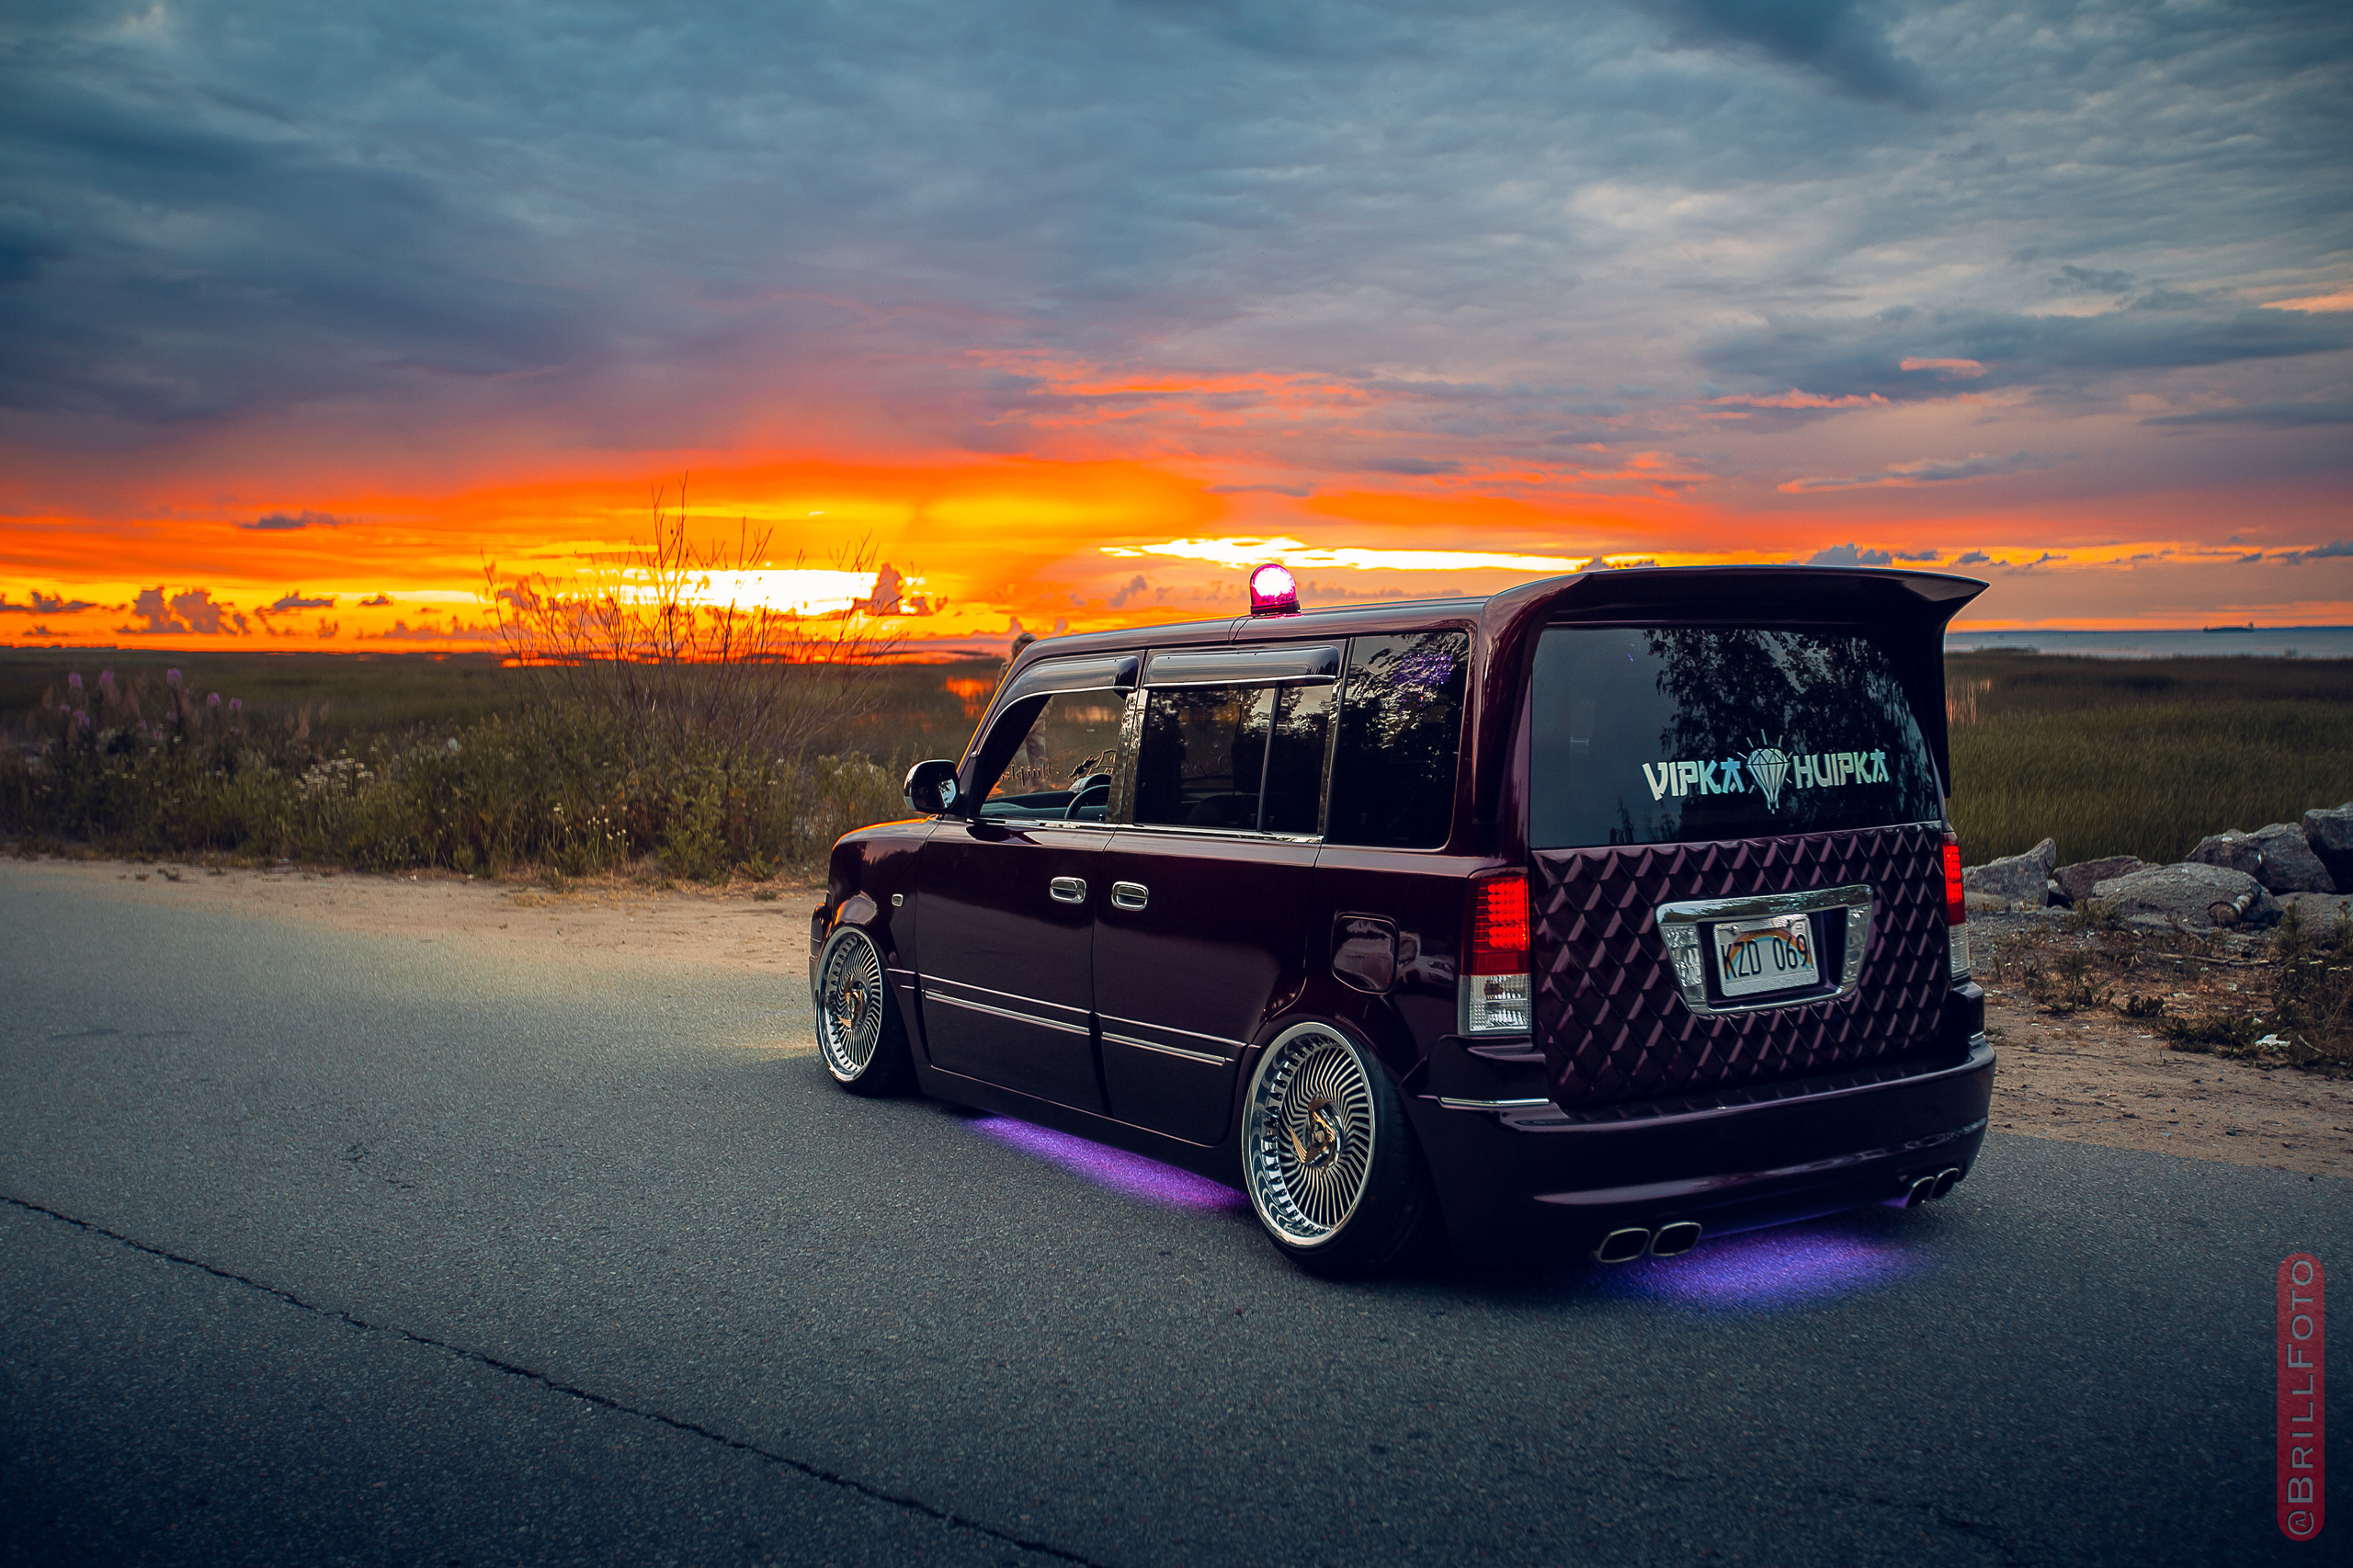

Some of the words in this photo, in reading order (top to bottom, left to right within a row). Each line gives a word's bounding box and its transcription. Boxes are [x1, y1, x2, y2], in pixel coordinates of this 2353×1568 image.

[1642, 757, 1745, 801] VIPKA
[1721, 939, 1762, 980] KZD
[1772, 934, 1808, 971] 069
